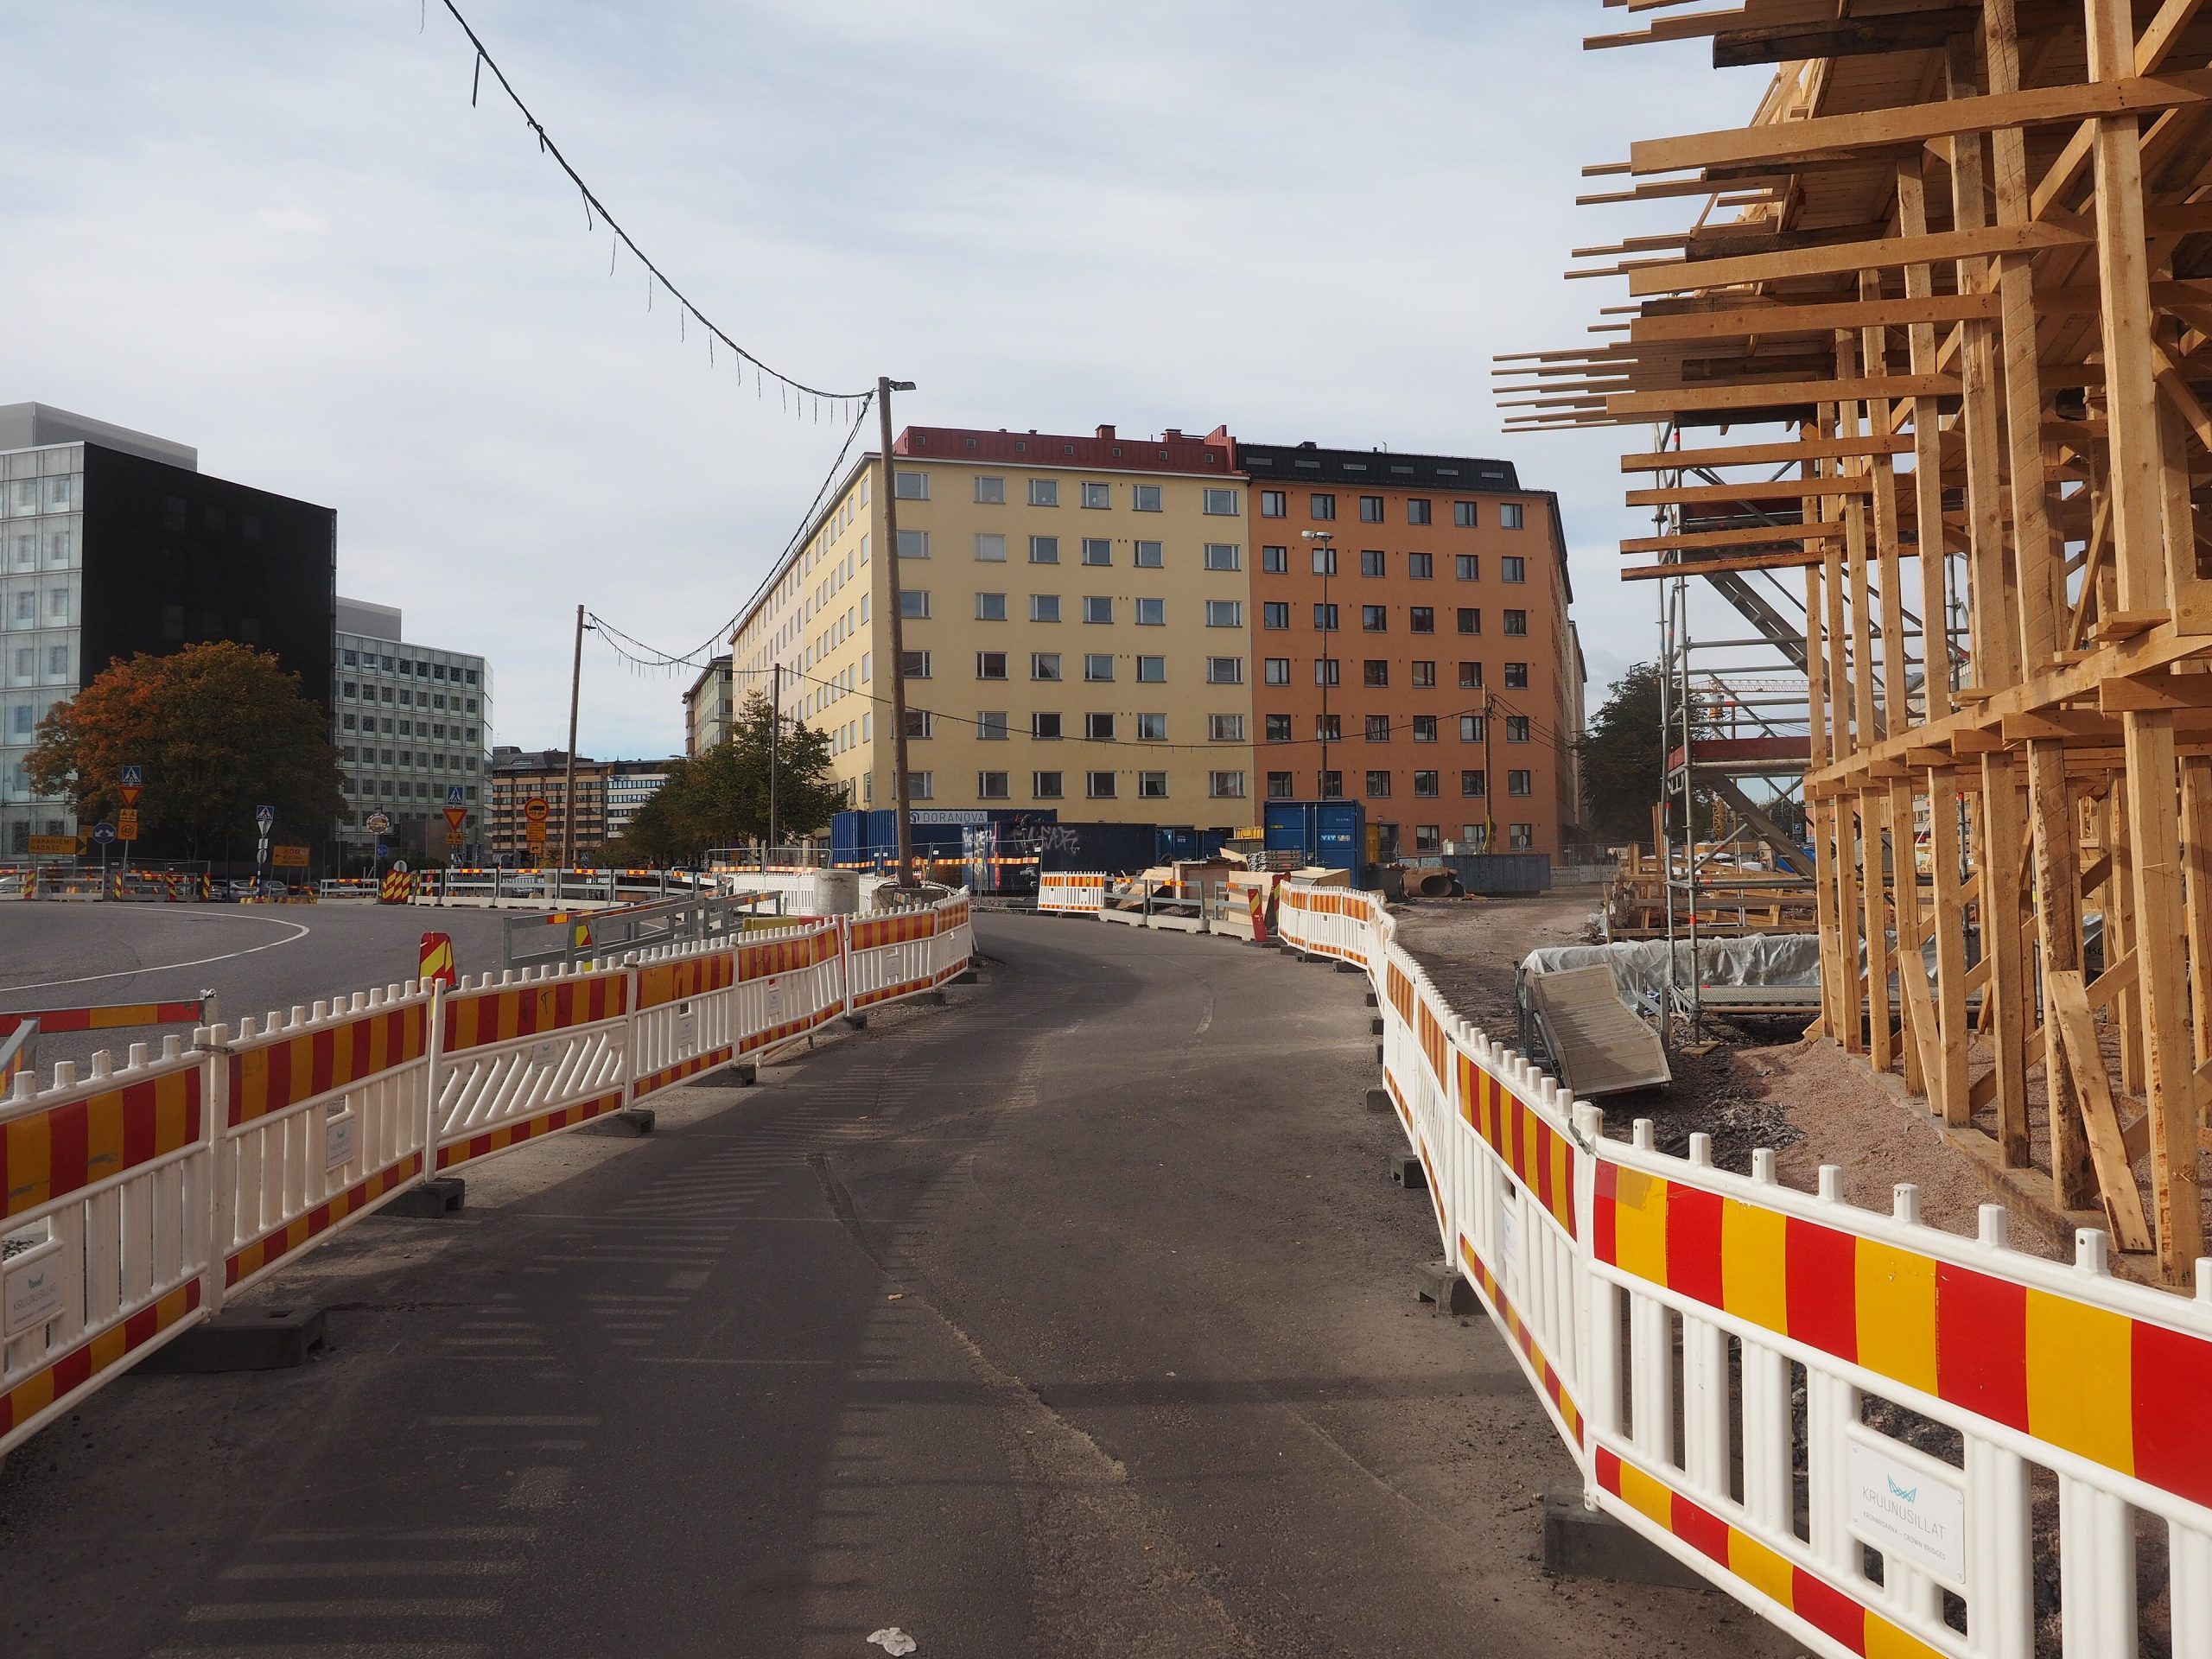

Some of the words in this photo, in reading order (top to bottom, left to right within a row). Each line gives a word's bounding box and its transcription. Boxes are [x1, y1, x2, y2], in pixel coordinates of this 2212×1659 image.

[923, 812, 985, 823] DORANOVA
[1862, 1486, 1946, 1540] KRUUNUSILLAT
[1863, 1511, 1898, 1535] KRONBROARNA
[1904, 1533, 1923, 1548] CROWN
[1923, 1543, 1946, 1560] BRIDGES
